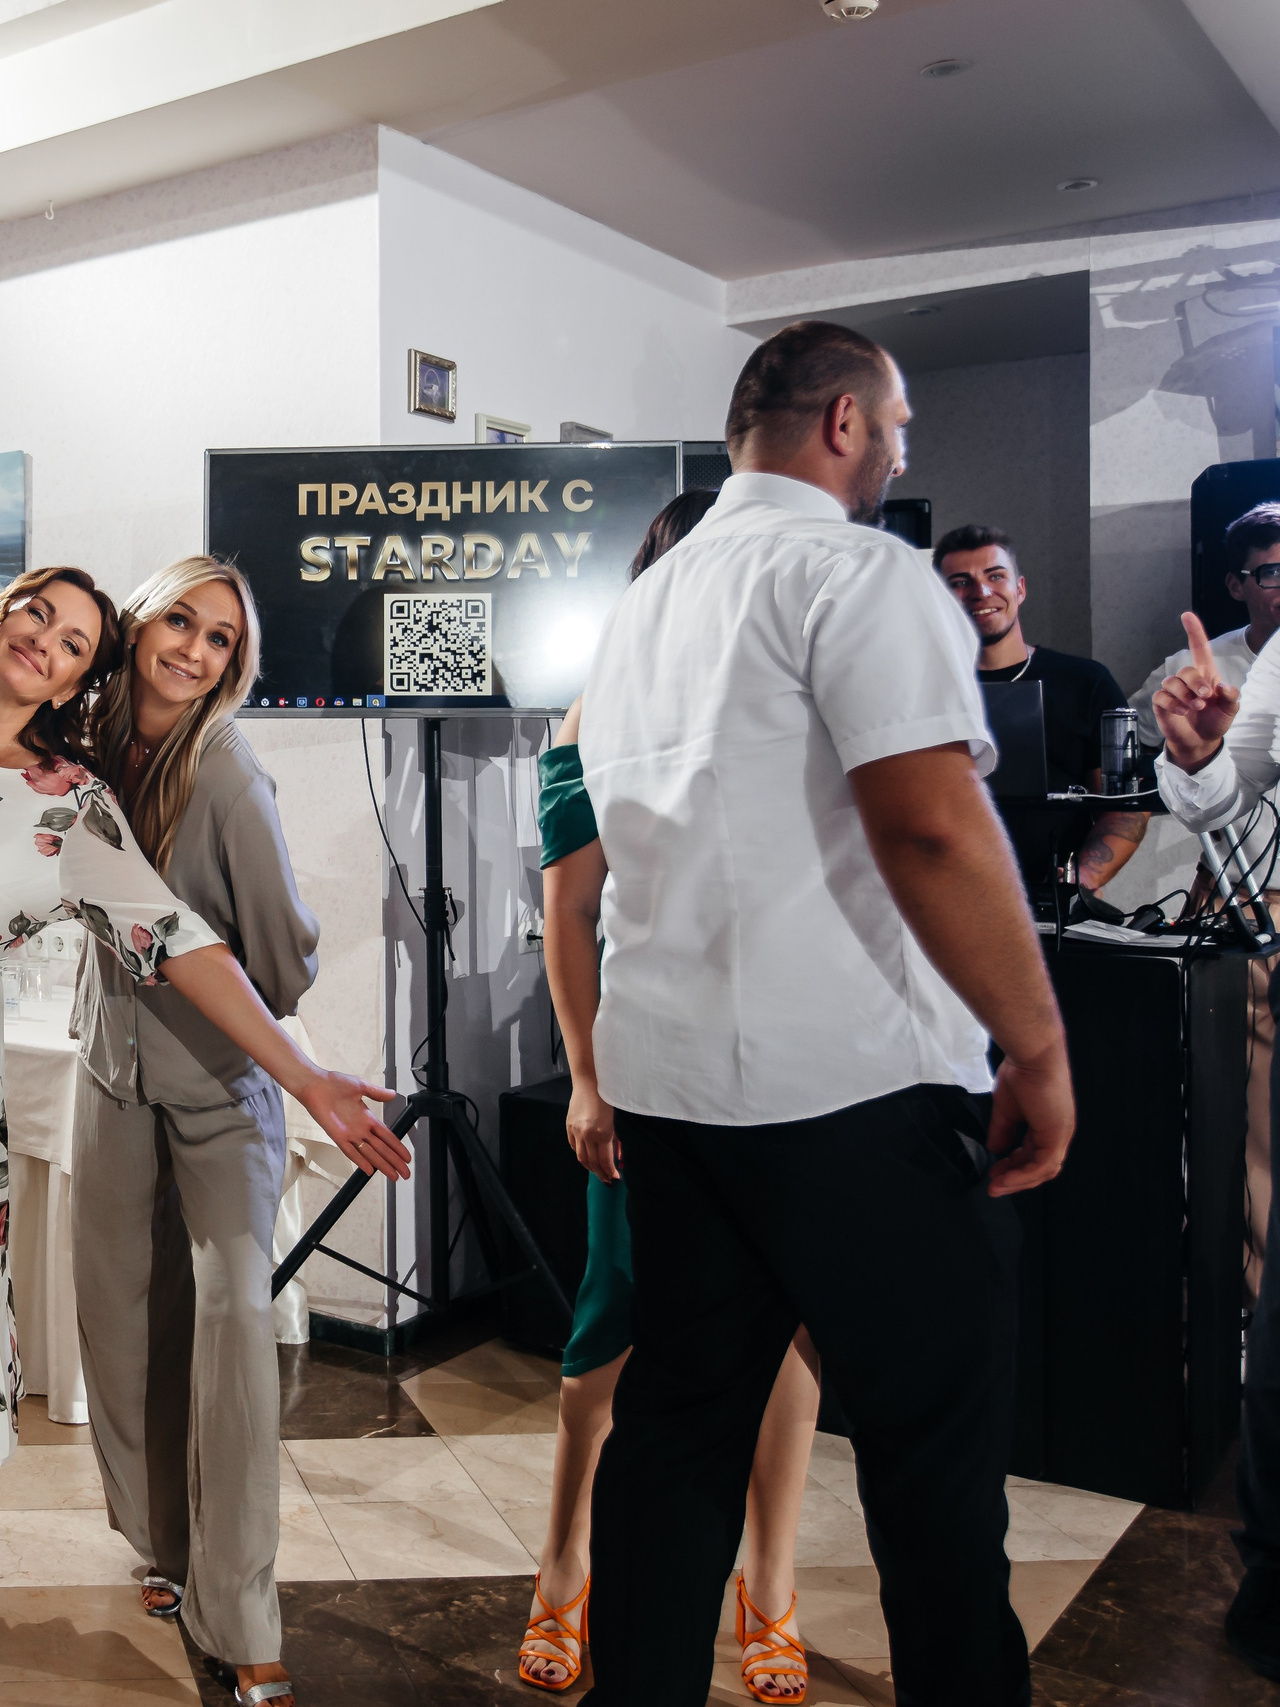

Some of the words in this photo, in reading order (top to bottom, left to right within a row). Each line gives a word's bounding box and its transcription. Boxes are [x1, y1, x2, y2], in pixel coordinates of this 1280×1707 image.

[298, 480, 550, 521] ПРАЗДНИК
[562, 479, 594, 513] С
[299, 532, 593, 582] STARDAY
